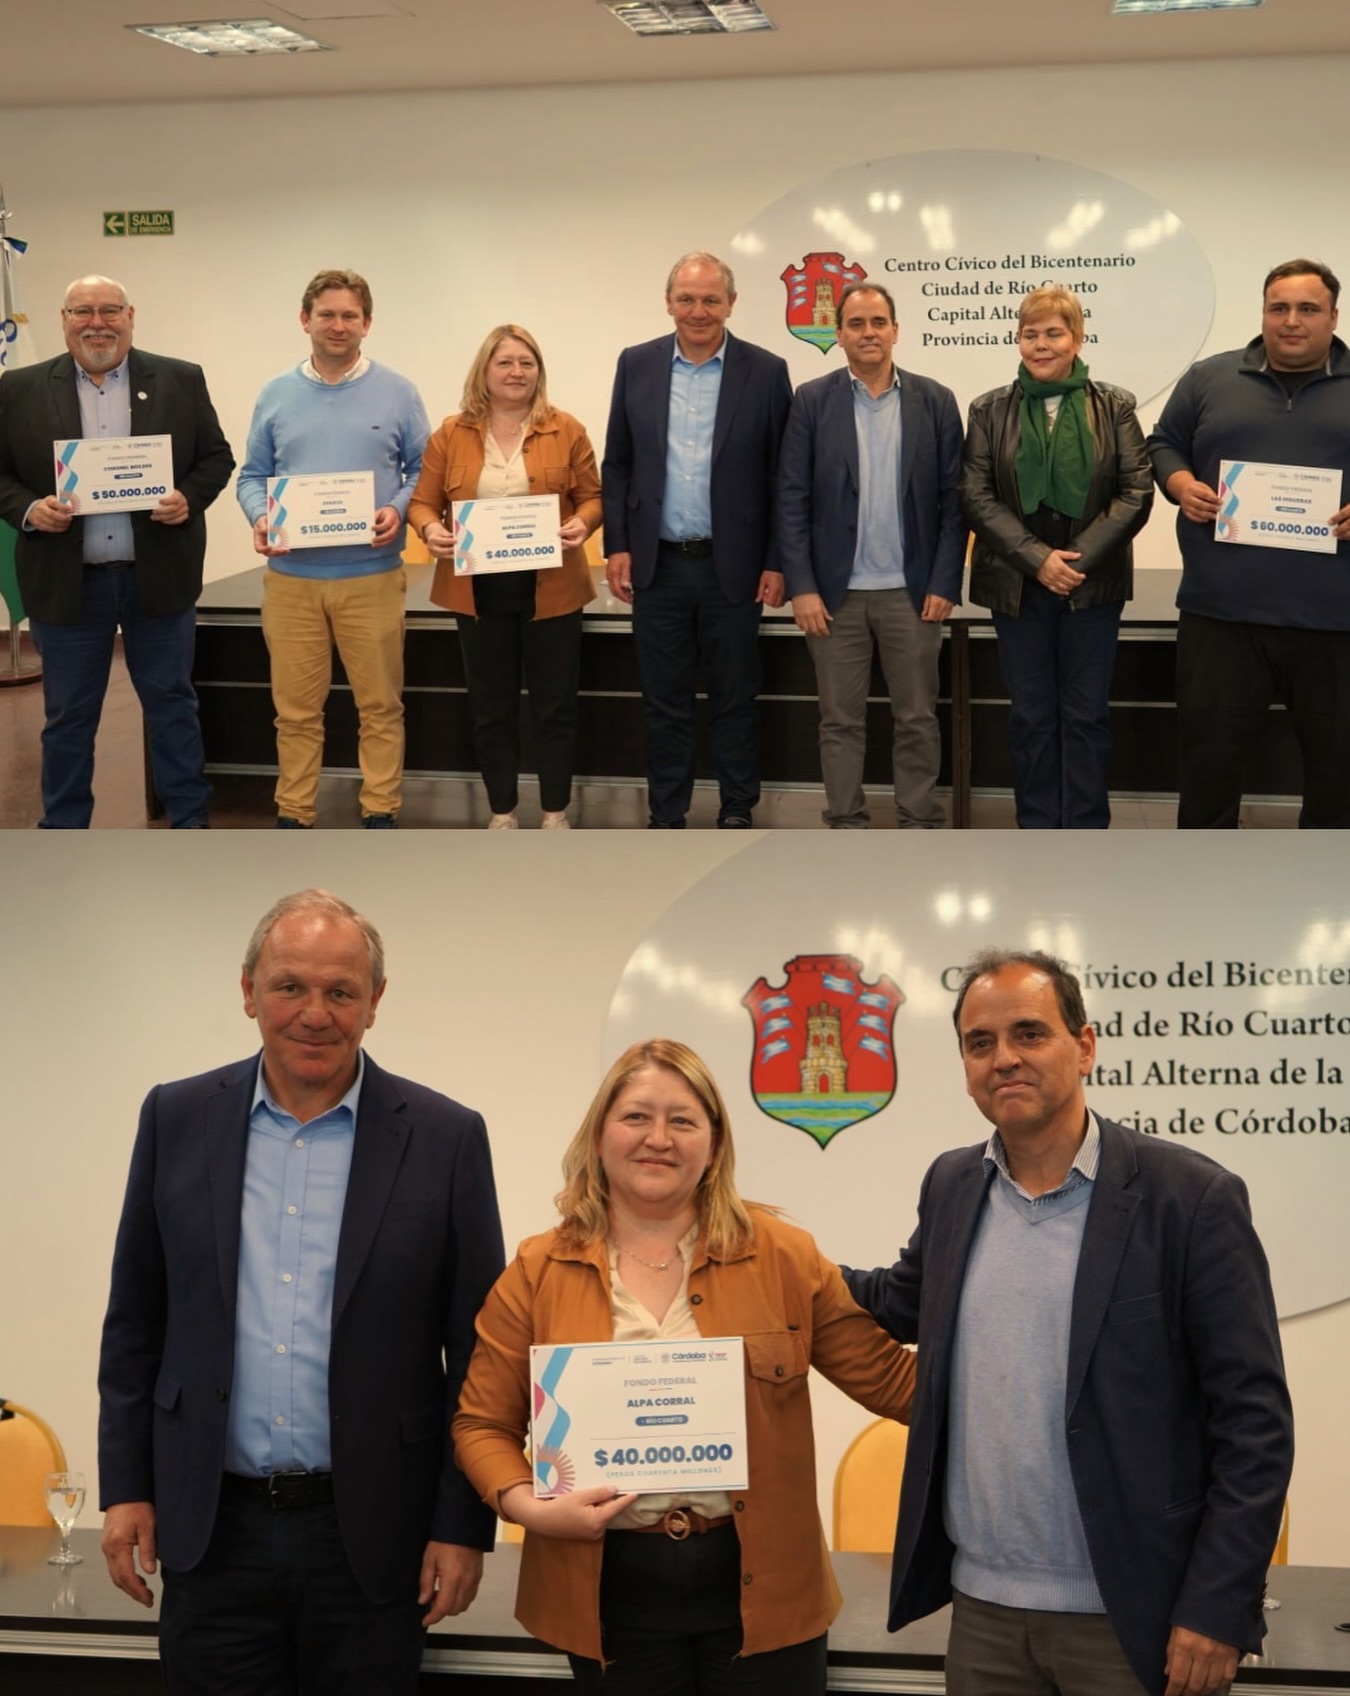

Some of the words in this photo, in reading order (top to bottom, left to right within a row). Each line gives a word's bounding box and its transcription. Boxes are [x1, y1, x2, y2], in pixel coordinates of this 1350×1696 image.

[132, 213, 170, 226] SALIDA
[884, 258, 941, 272] Centro
[944, 256, 997, 271] Cívico
[1001, 255, 1026, 270] del
[1030, 253, 1136, 269] Bicentenario
[921, 281, 980, 297] Ciudad
[984, 280, 1003, 295] de
[1008, 280, 1036, 294] Río
[927, 305, 986, 325] Capital
[990, 305, 1020, 320] Alte
[922, 331, 999, 346] Provincia
[1070, 963, 1158, 989] ívico
[1167, 960, 1214, 988] del
[1133, 1010, 1170, 1038] de
[1179, 1009, 1235, 1038] Río
[1142, 1058, 1261, 1086] Alterna
[1269, 1057, 1308, 1085] de
[1315, 1056, 1344, 1085] la
[1168, 1107, 1206, 1135] de
[623, 1378, 657, 1388] FONDO
[658, 1376, 698, 1386] FEDERAL
[626, 1399, 654, 1408] ALPA
[655, 1397, 697, 1407] CORRAL
[658, 1416, 684, 1424] CUARTO
[637, 1469, 678, 1477] CUARENTA
